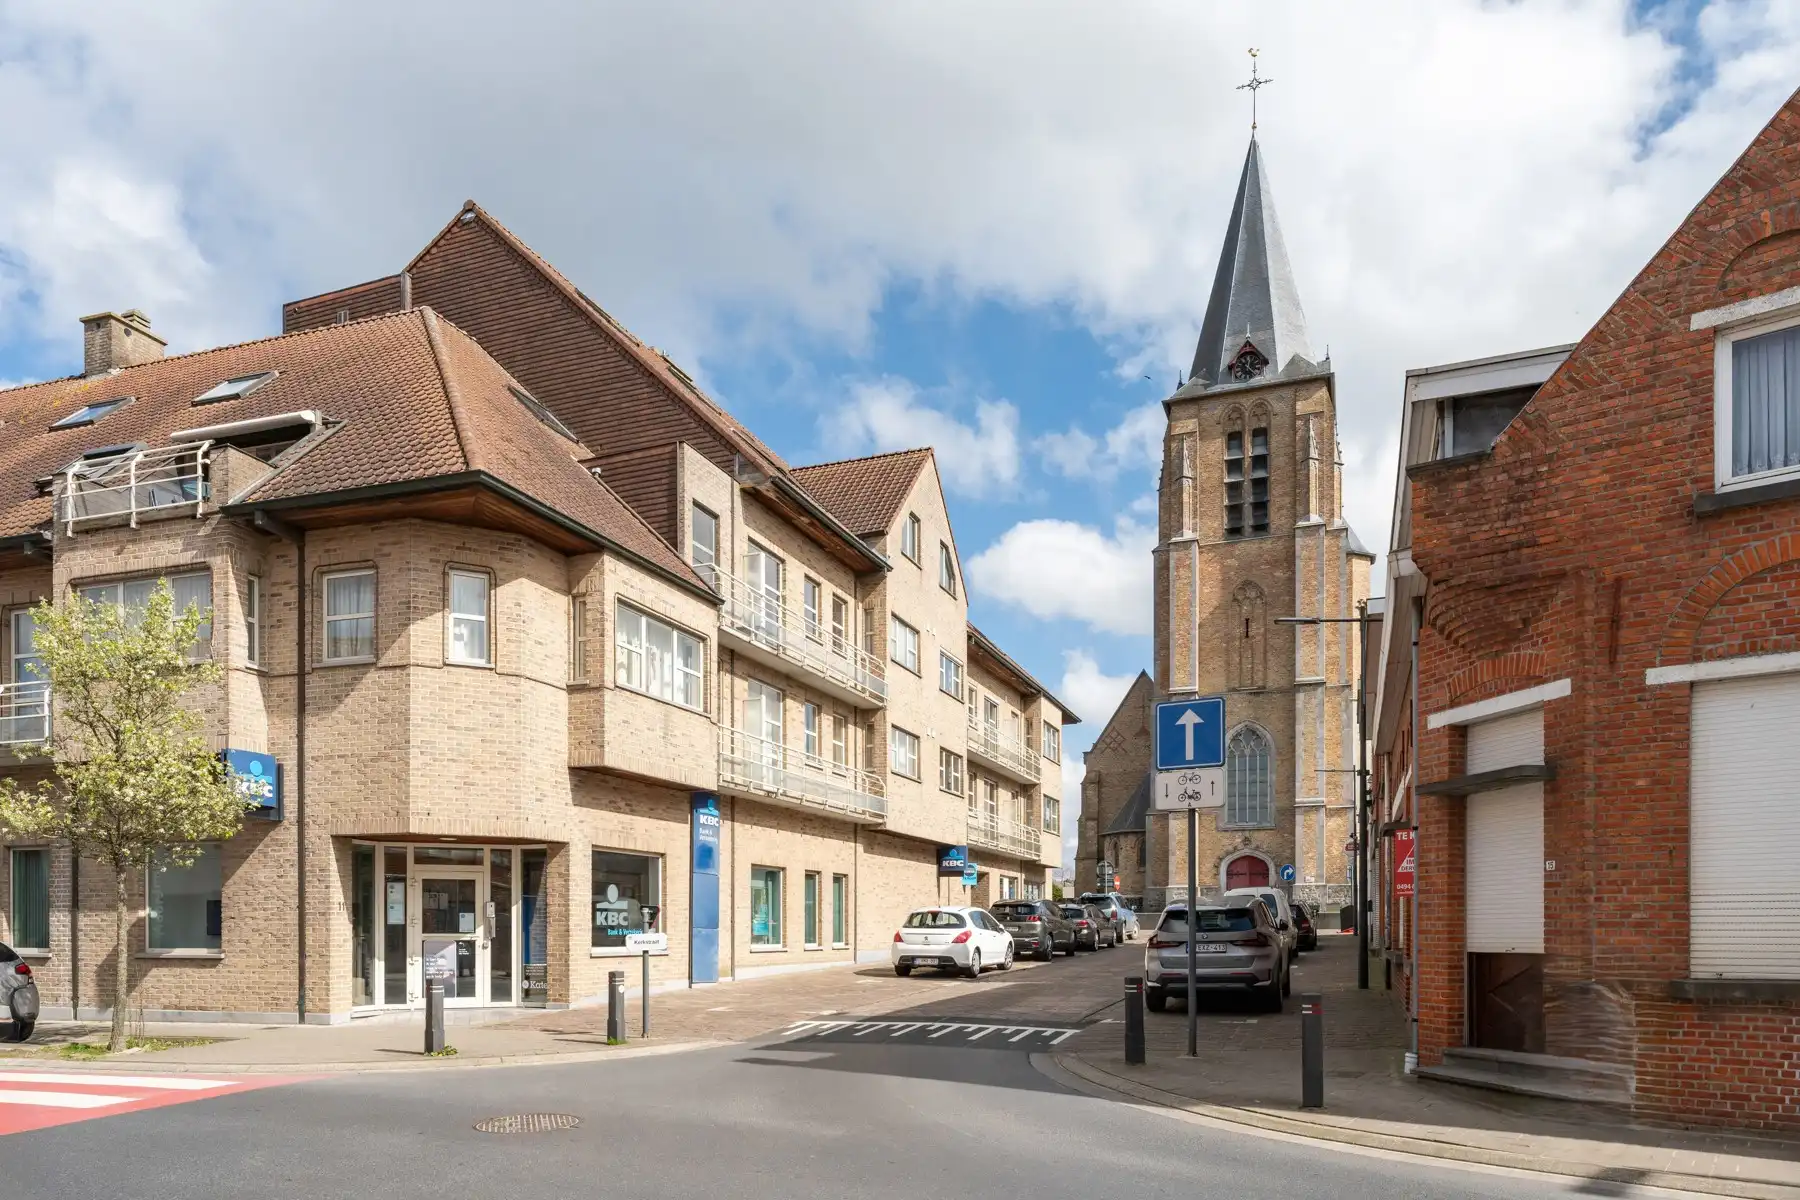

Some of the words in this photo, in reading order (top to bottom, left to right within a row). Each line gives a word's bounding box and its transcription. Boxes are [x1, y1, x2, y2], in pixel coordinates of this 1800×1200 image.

[699, 814, 719, 827] KBC
[1396, 831, 1408, 840] TE
[596, 911, 629, 926] KBC
[607, 928, 619, 936] Bank
